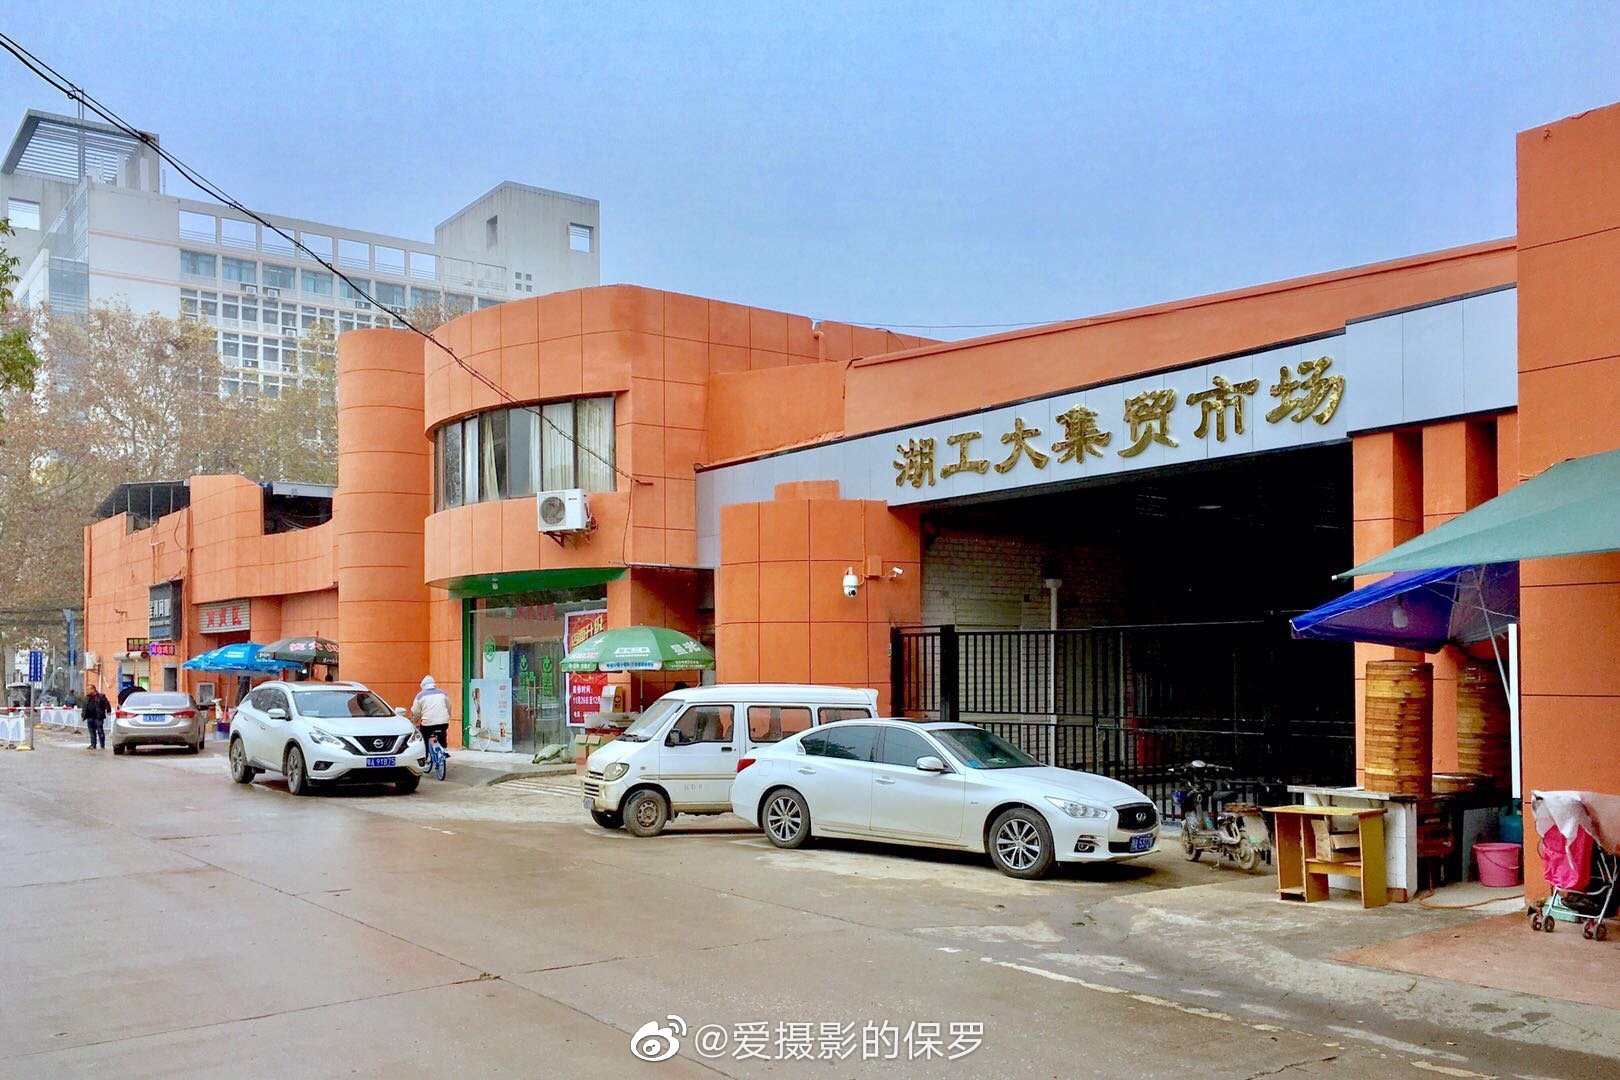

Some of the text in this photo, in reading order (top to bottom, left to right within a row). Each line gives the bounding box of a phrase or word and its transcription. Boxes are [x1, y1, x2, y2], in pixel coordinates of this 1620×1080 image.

[893, 356, 1346, 488] 湖工大集贸市场
